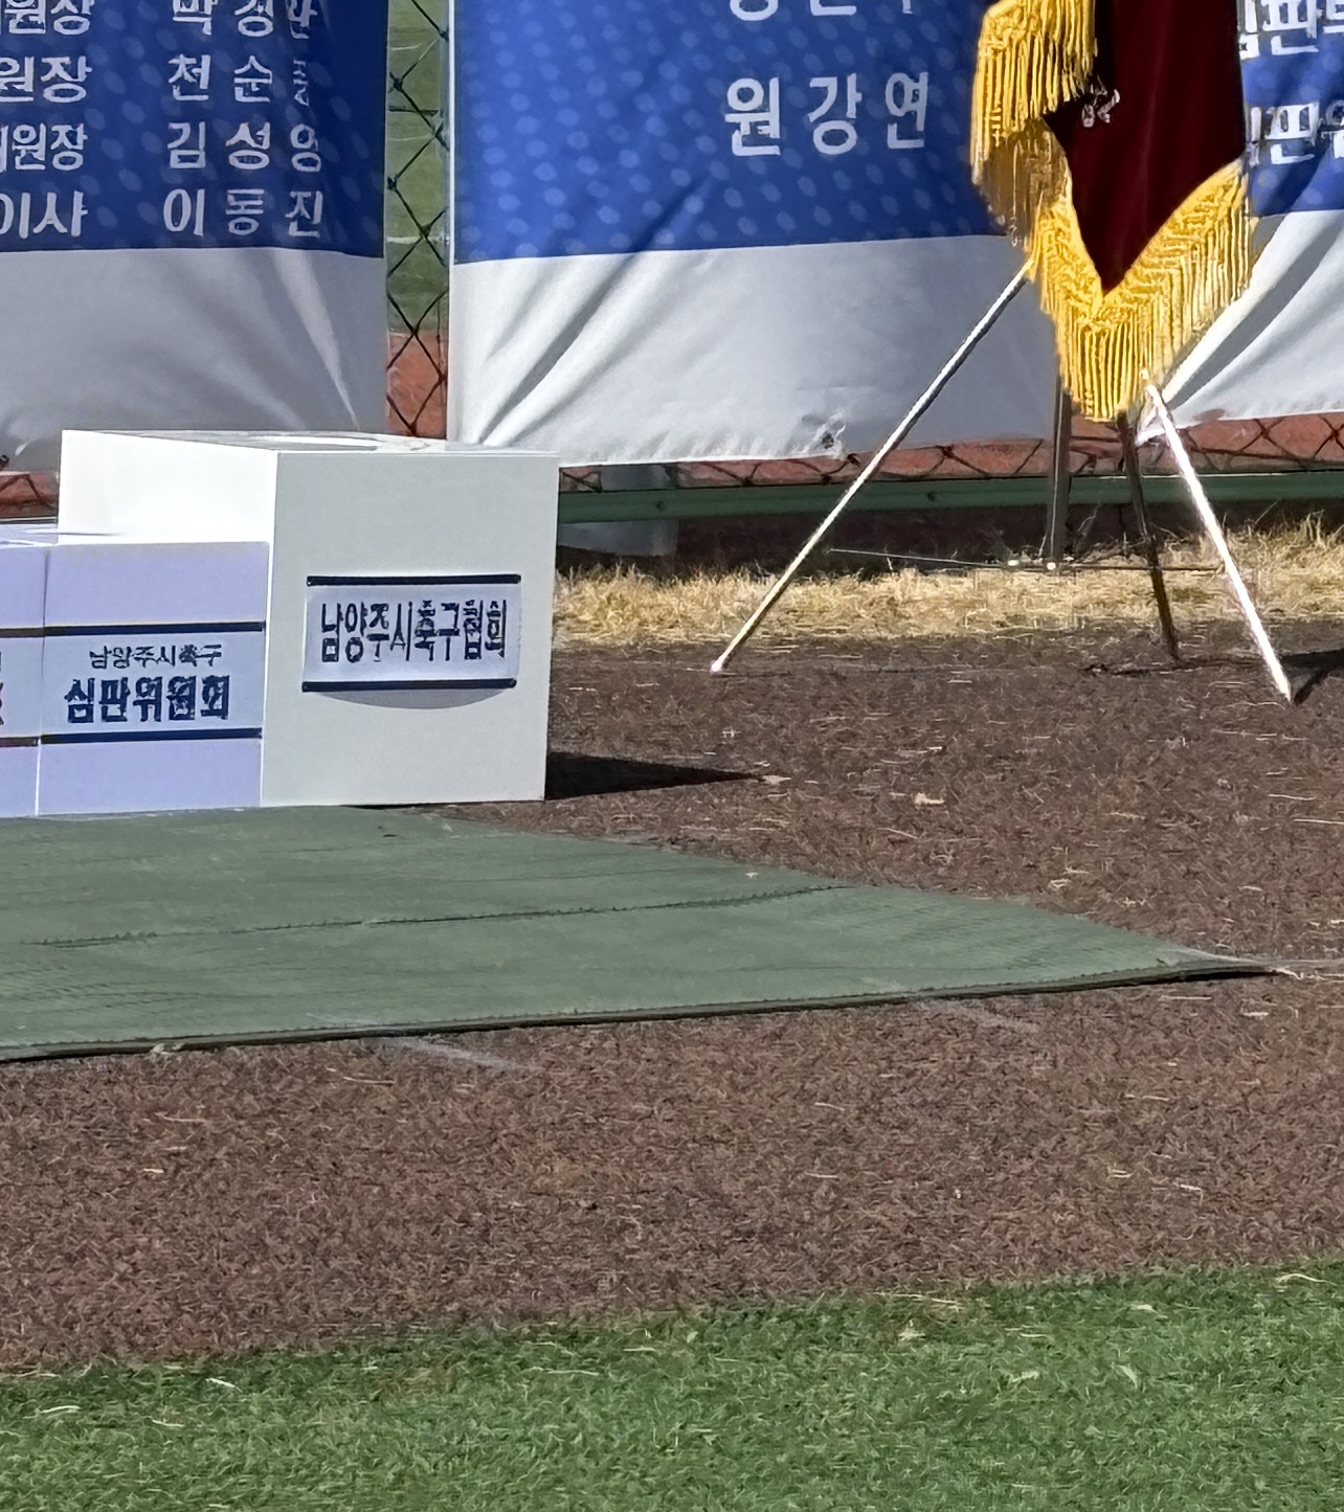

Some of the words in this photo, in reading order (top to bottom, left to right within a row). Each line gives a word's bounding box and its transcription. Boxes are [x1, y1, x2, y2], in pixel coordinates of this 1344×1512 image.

[89, 643, 223, 670] 남양주시축구
[319, 599, 508, 664] 남양주시축구협회
[63, 674, 231, 724] 심판위원회
